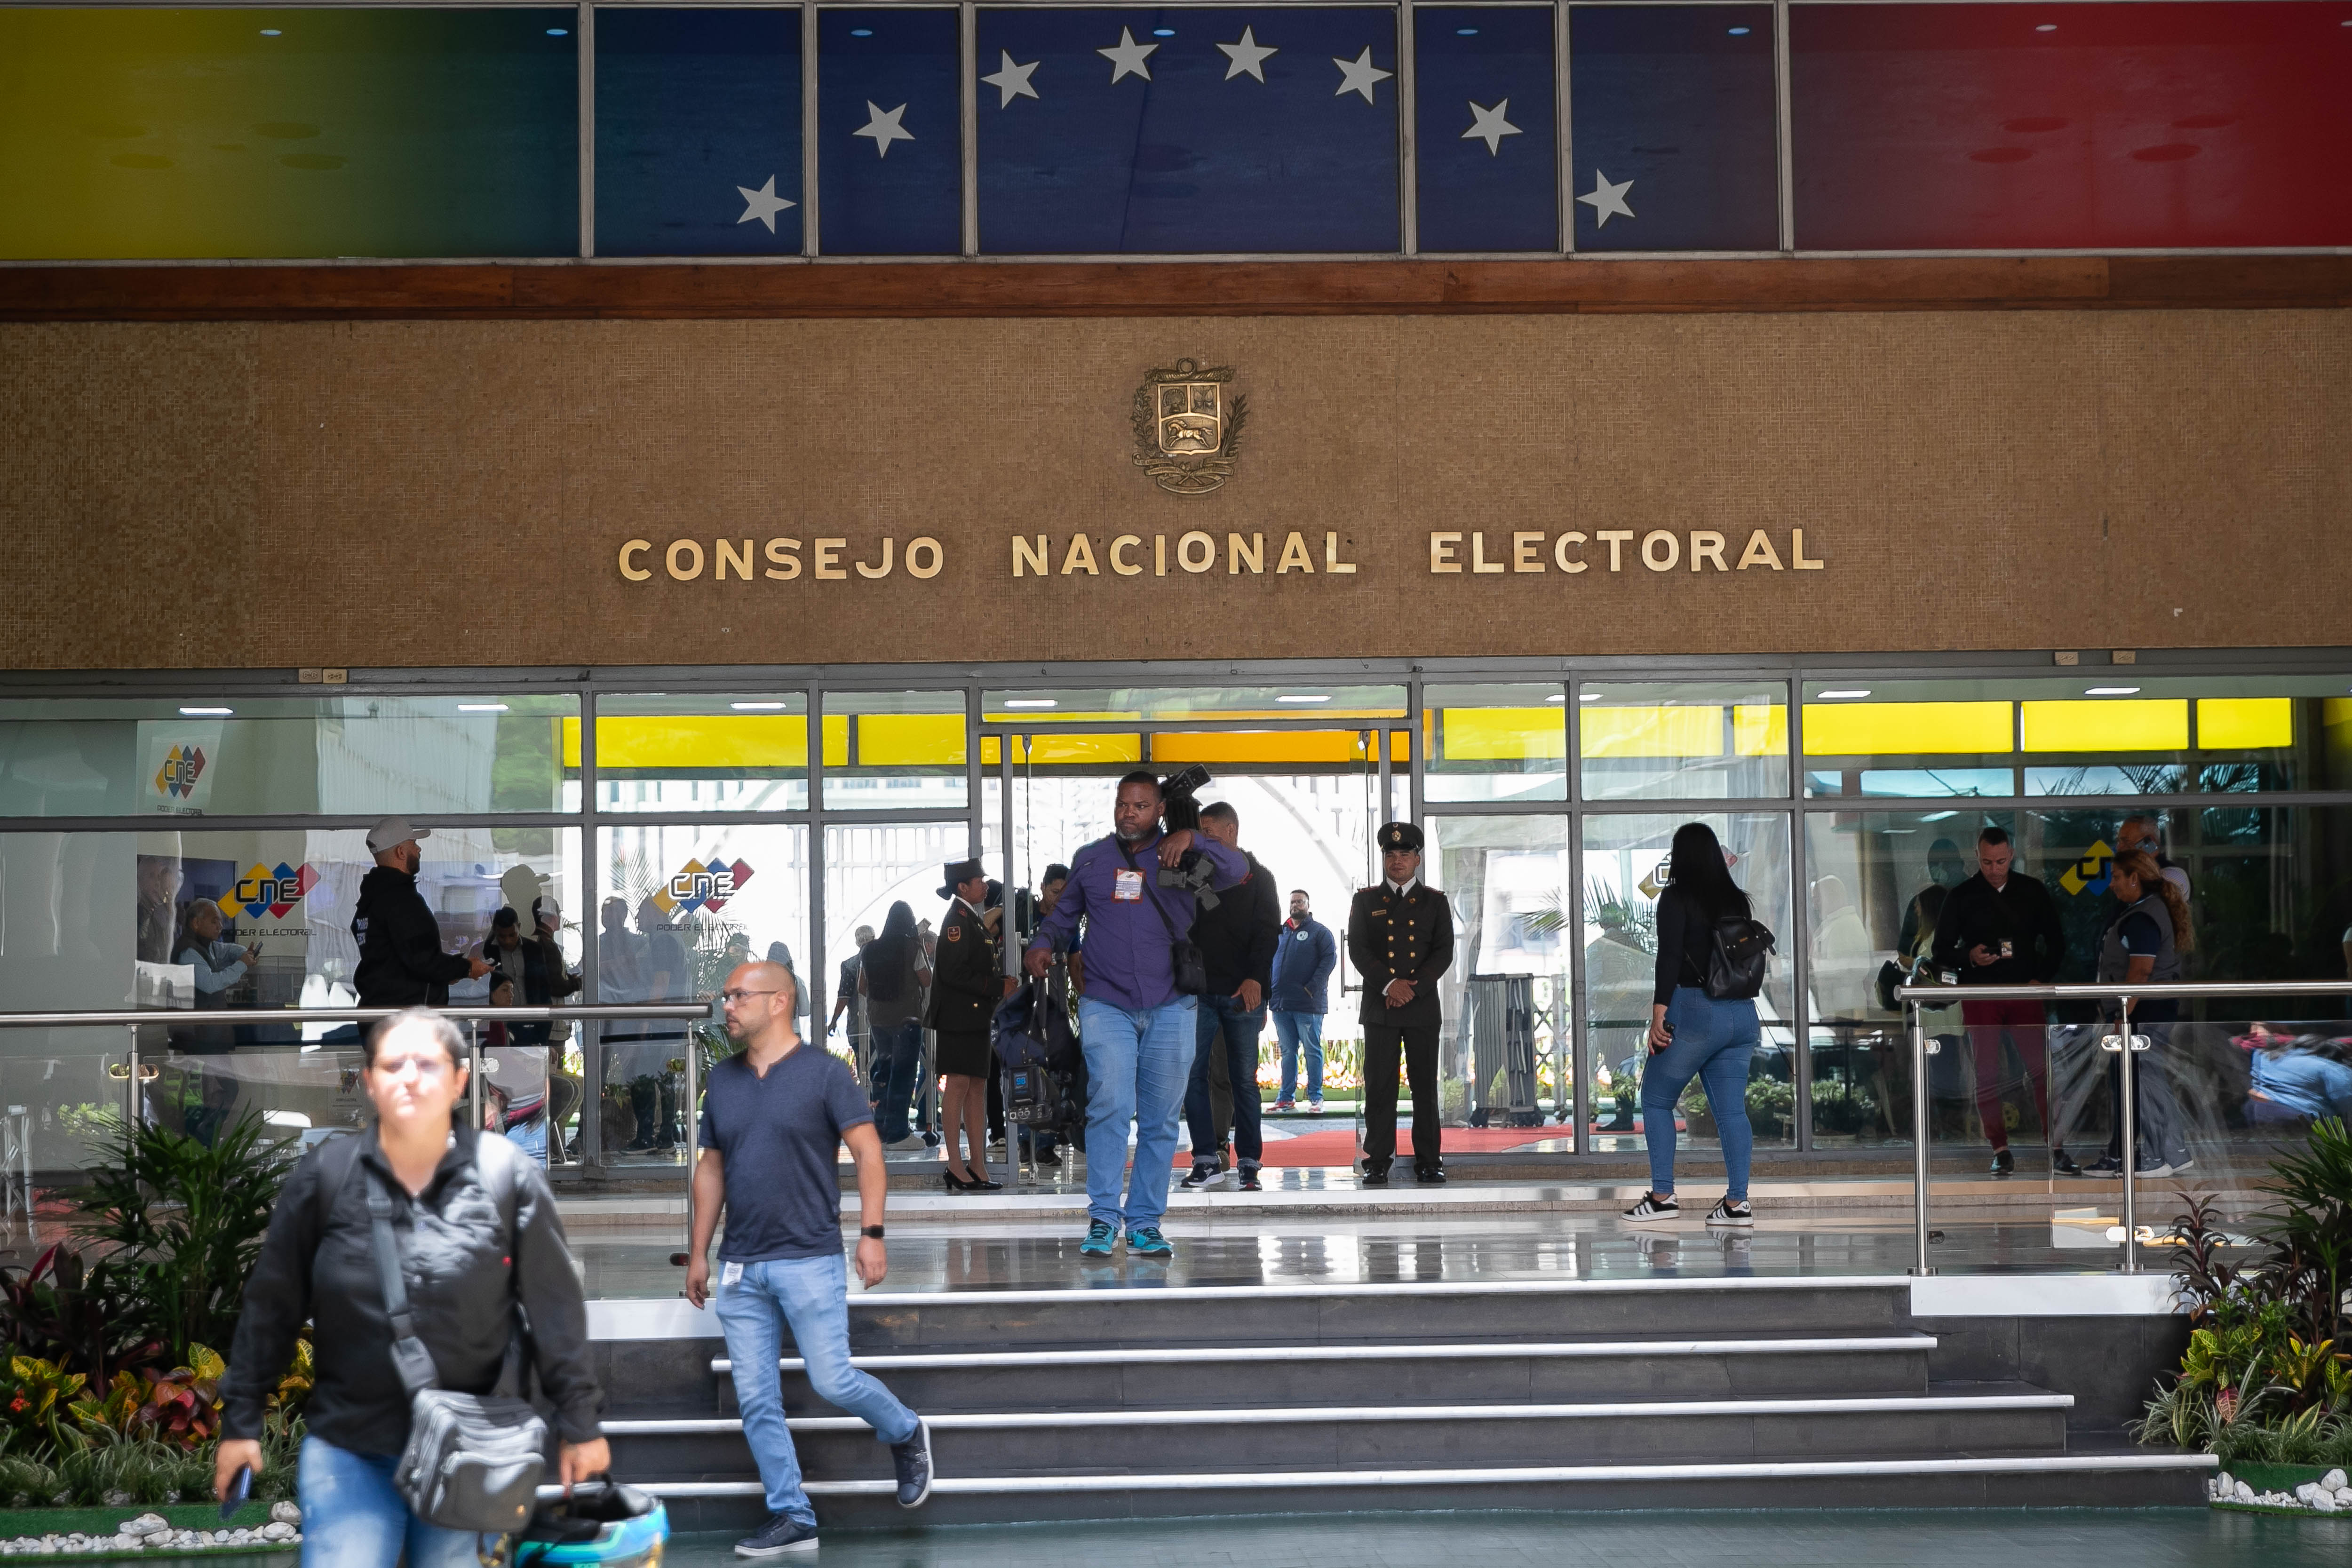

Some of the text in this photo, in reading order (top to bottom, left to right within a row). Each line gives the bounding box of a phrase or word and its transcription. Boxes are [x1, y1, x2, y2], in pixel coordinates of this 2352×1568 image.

[619, 528, 1825, 581] CONSEJO NACIONAL ELECTORAL
[165, 759, 197, 784] CNE
[236, 879, 302, 903] CNE
[670, 874, 735, 898] CNE
